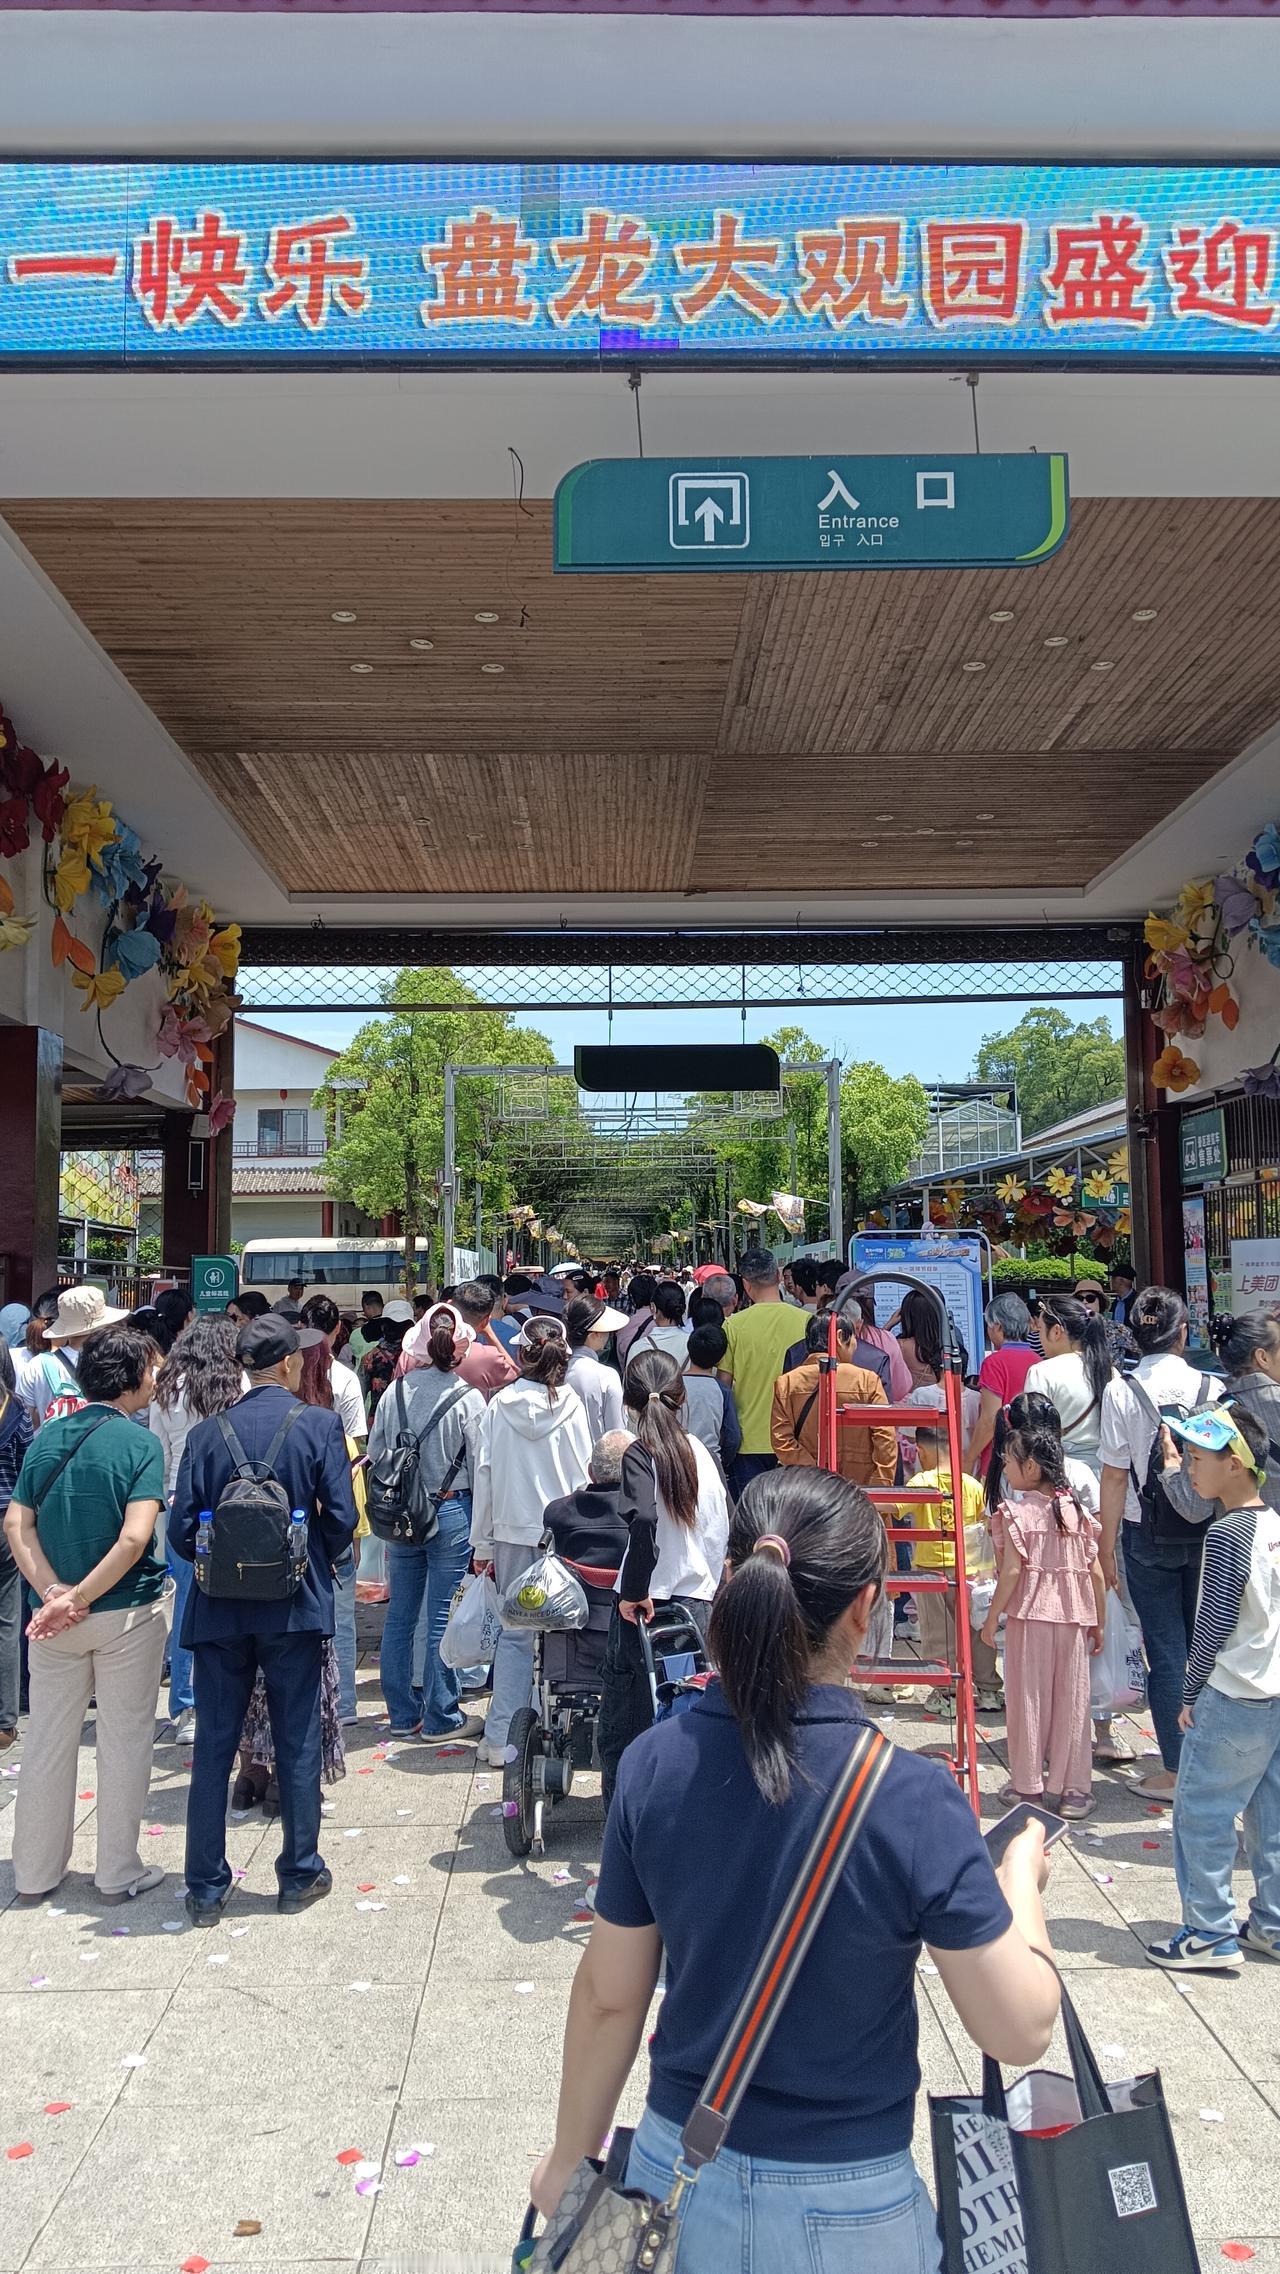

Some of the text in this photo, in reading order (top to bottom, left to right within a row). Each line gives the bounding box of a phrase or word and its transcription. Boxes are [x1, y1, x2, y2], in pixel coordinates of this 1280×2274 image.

[420, 205, 1279, 335] 盘龙大观园盛迎
[817, 469, 955, 511] 入口
[818, 514, 900, 529] Entrance
[819, 533, 883, 548] 입구 入口
[1199, 1145, 1221, 1168] 售票处
[1236, 1274, 1279, 1295] 上美团
